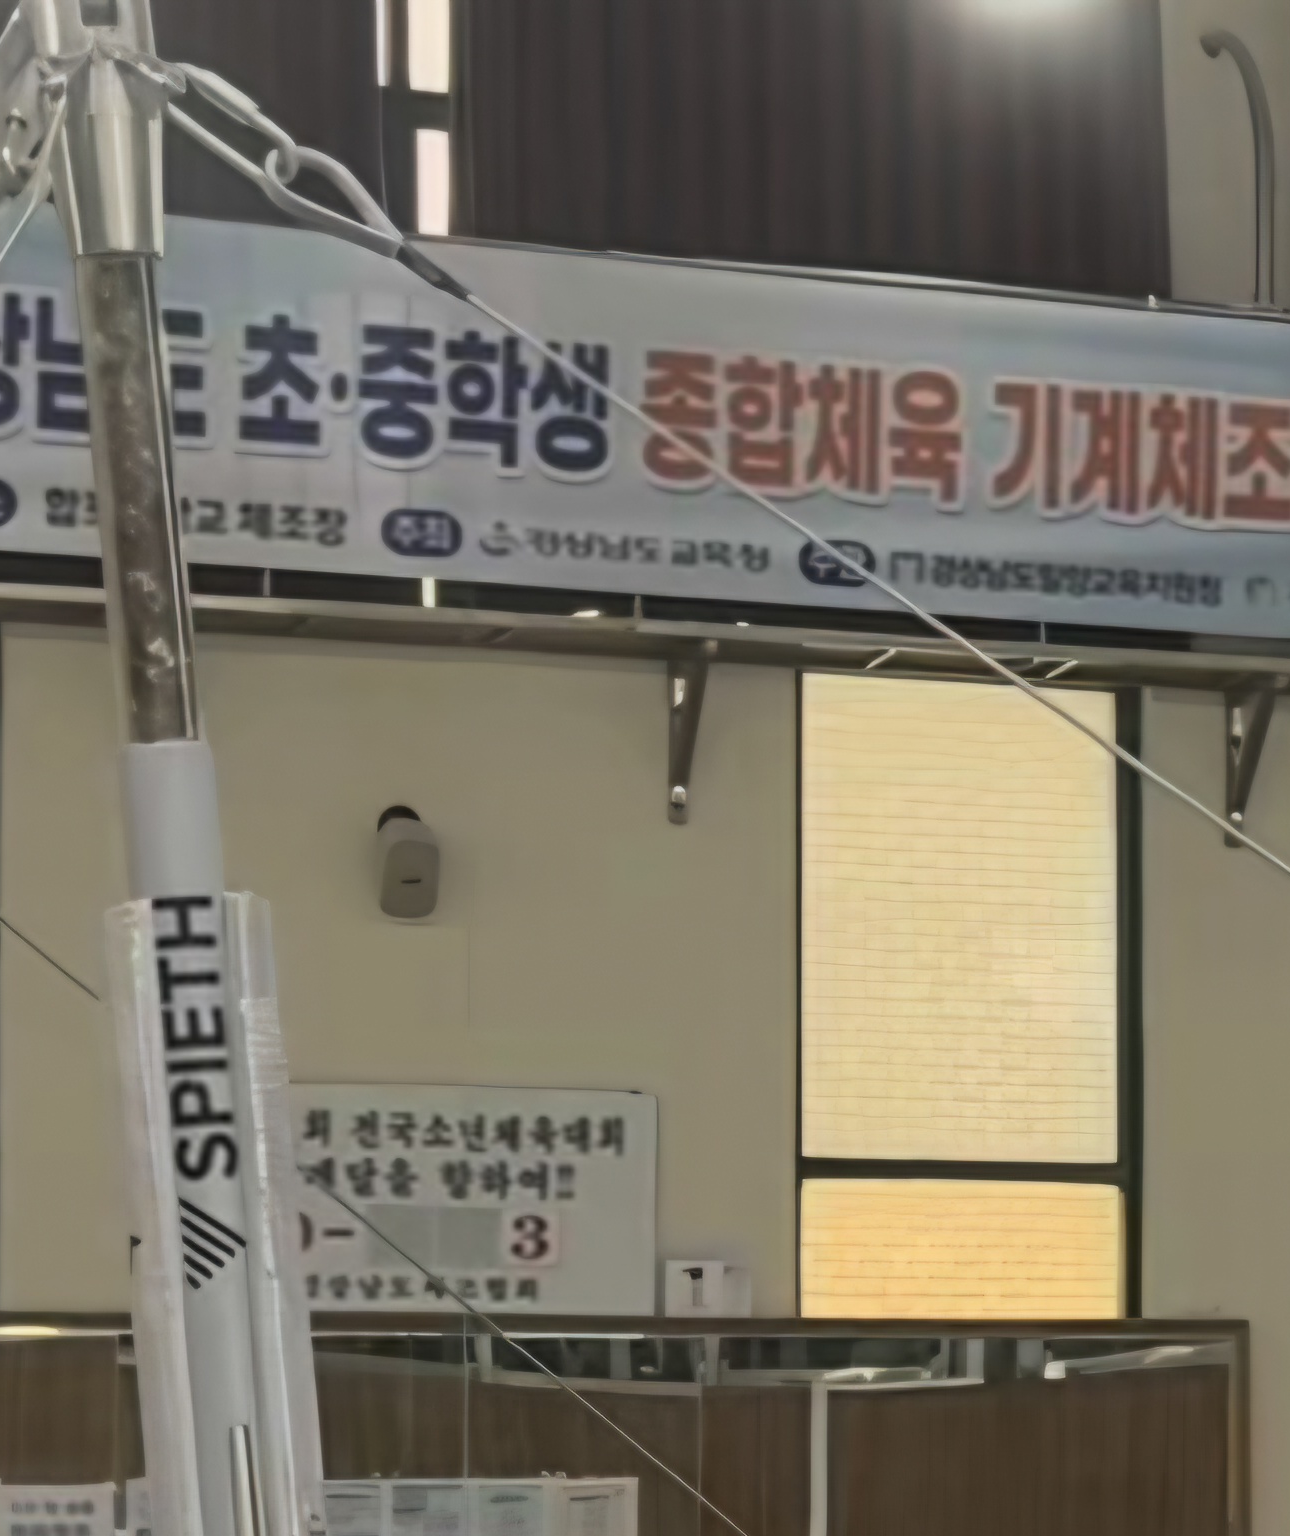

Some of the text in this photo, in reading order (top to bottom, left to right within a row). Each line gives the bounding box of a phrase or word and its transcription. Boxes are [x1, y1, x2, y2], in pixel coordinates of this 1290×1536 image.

[239, 314, 609, 473] 초·중학생
[642, 349, 963, 503] 종합체육
[150, 895, 240, 1182] SPIETH
[510, 1214, 550, 1261] 3
